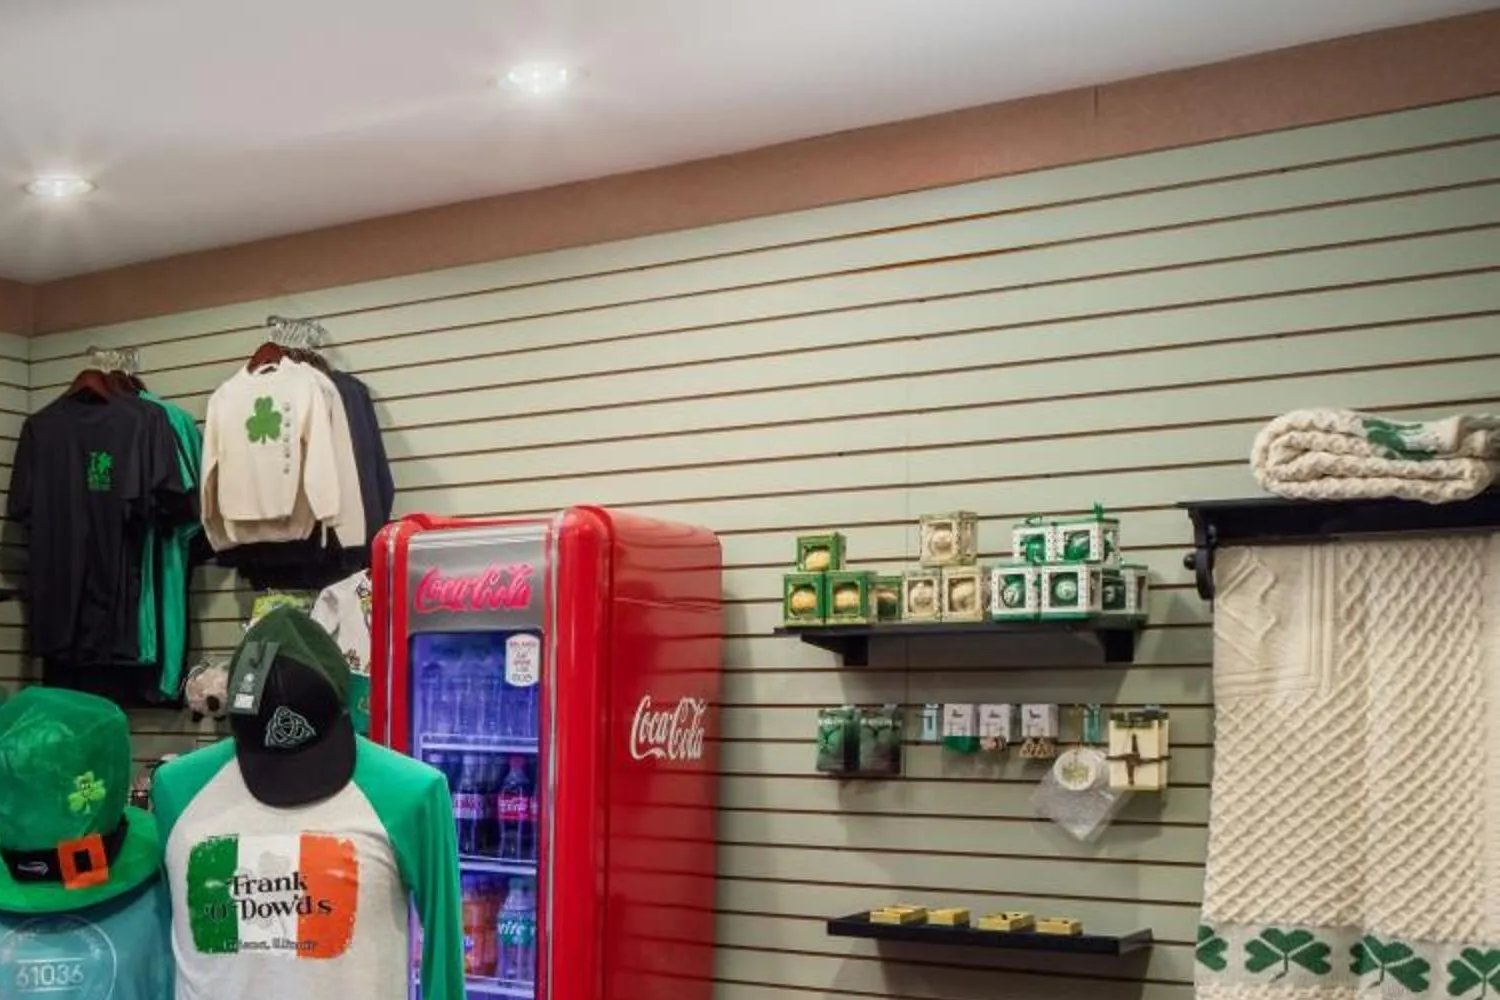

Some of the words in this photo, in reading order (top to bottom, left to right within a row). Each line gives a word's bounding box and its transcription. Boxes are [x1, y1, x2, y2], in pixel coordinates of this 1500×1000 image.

[414, 563, 534, 614] Coca-Cola
[630, 692, 707, 760] Coca-Cola
[227, 872, 308, 896] Frank
[17, 964, 84, 988] 61036
